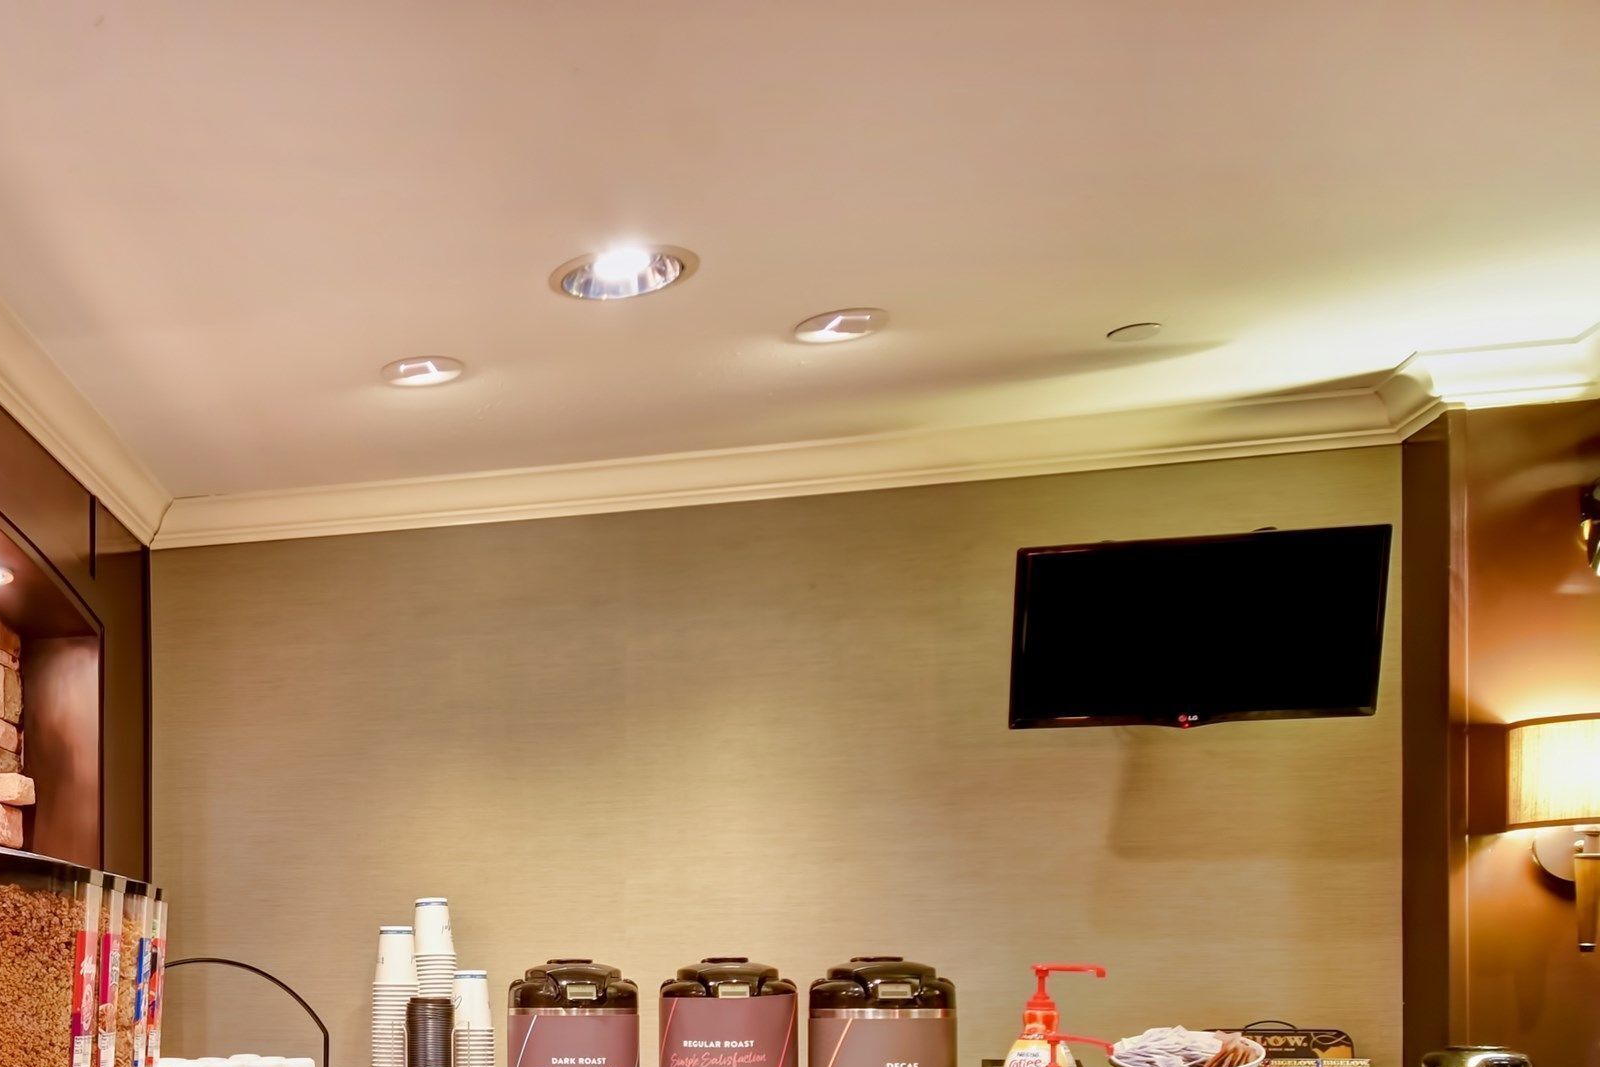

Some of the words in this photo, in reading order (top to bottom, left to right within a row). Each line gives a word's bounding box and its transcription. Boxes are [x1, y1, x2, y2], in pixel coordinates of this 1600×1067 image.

[683, 1040, 721, 1048] REGULAR
[724, 1040, 755, 1048] ROAST
[552, 1057, 576, 1065] DARK
[578, 1057, 606, 1065] ROAST
